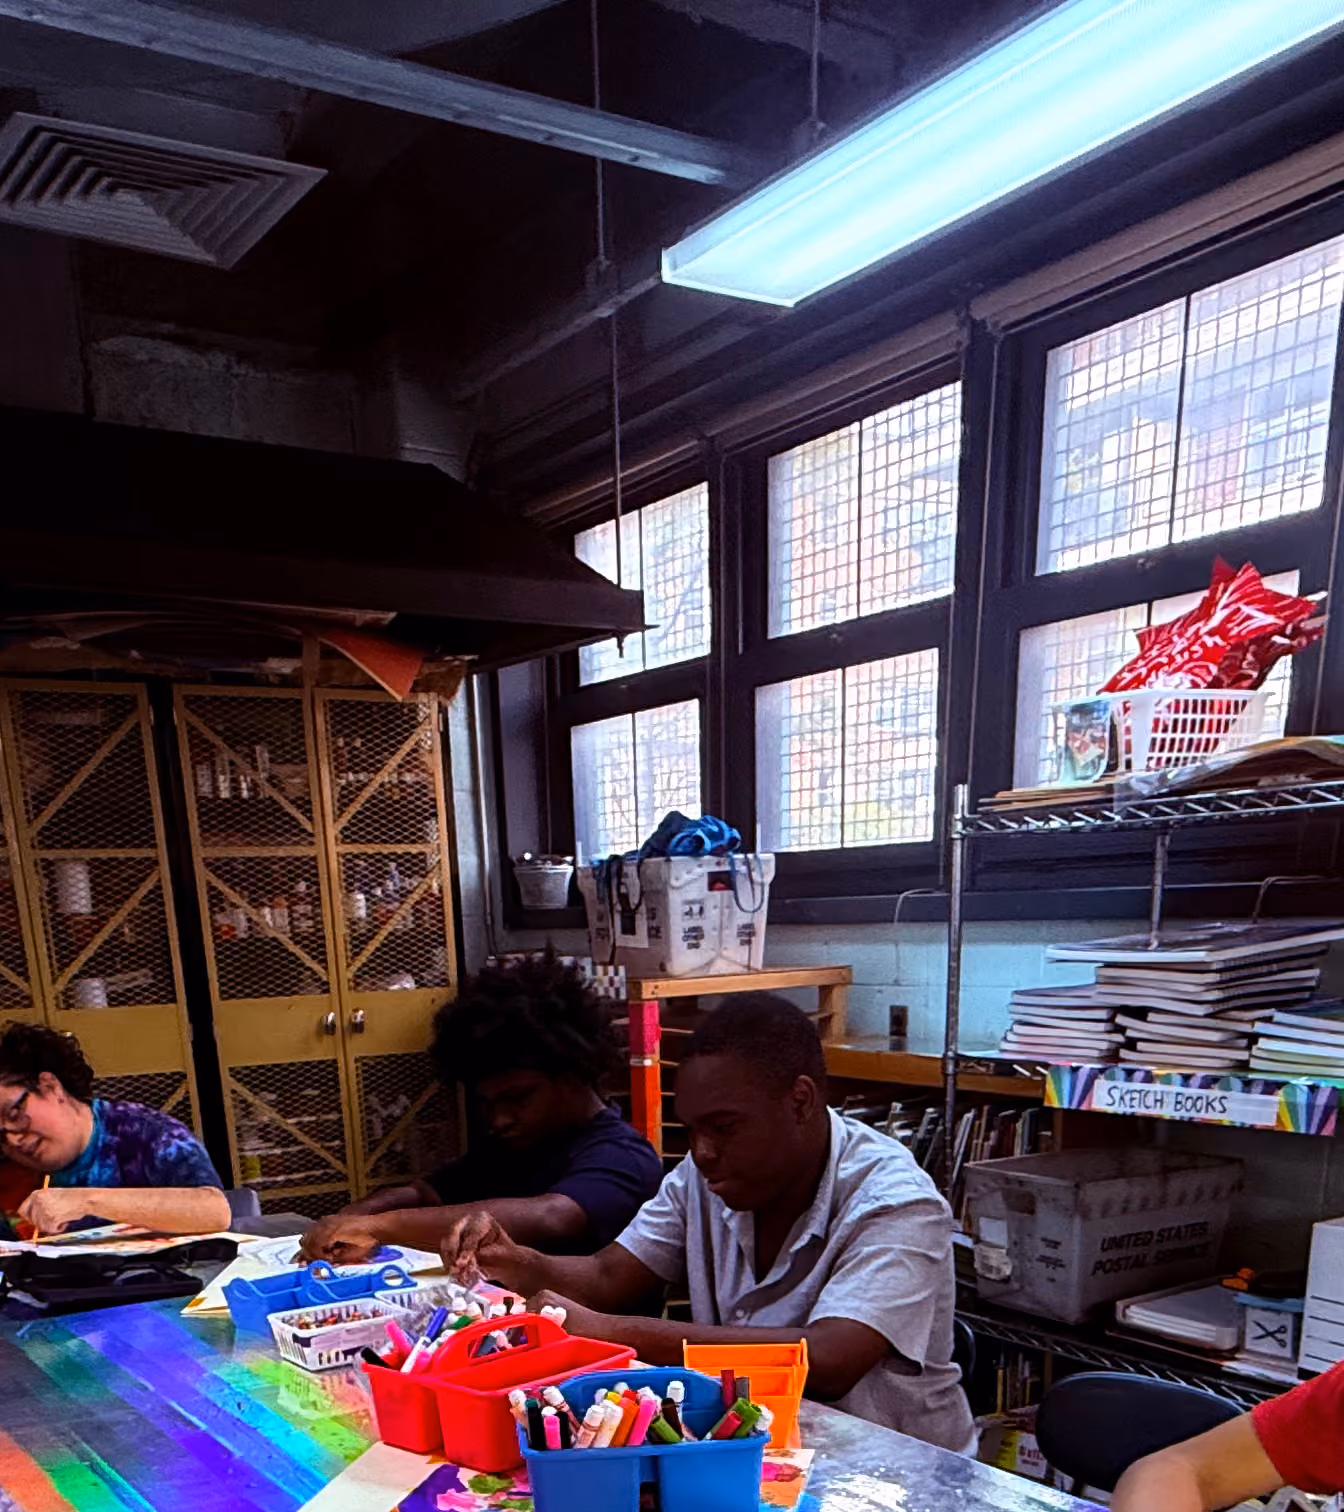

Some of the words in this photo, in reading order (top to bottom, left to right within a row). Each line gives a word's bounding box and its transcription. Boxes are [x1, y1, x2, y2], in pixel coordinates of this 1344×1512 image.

[1106, 1084, 1166, 1110] SKETCH
[1173, 1092, 1230, 1115] BOOKS
[1100, 1229, 1155, 1253] UNITED
[1156, 1220, 1211, 1245] STATES
[1091, 1252, 1148, 1278] POSTAL
